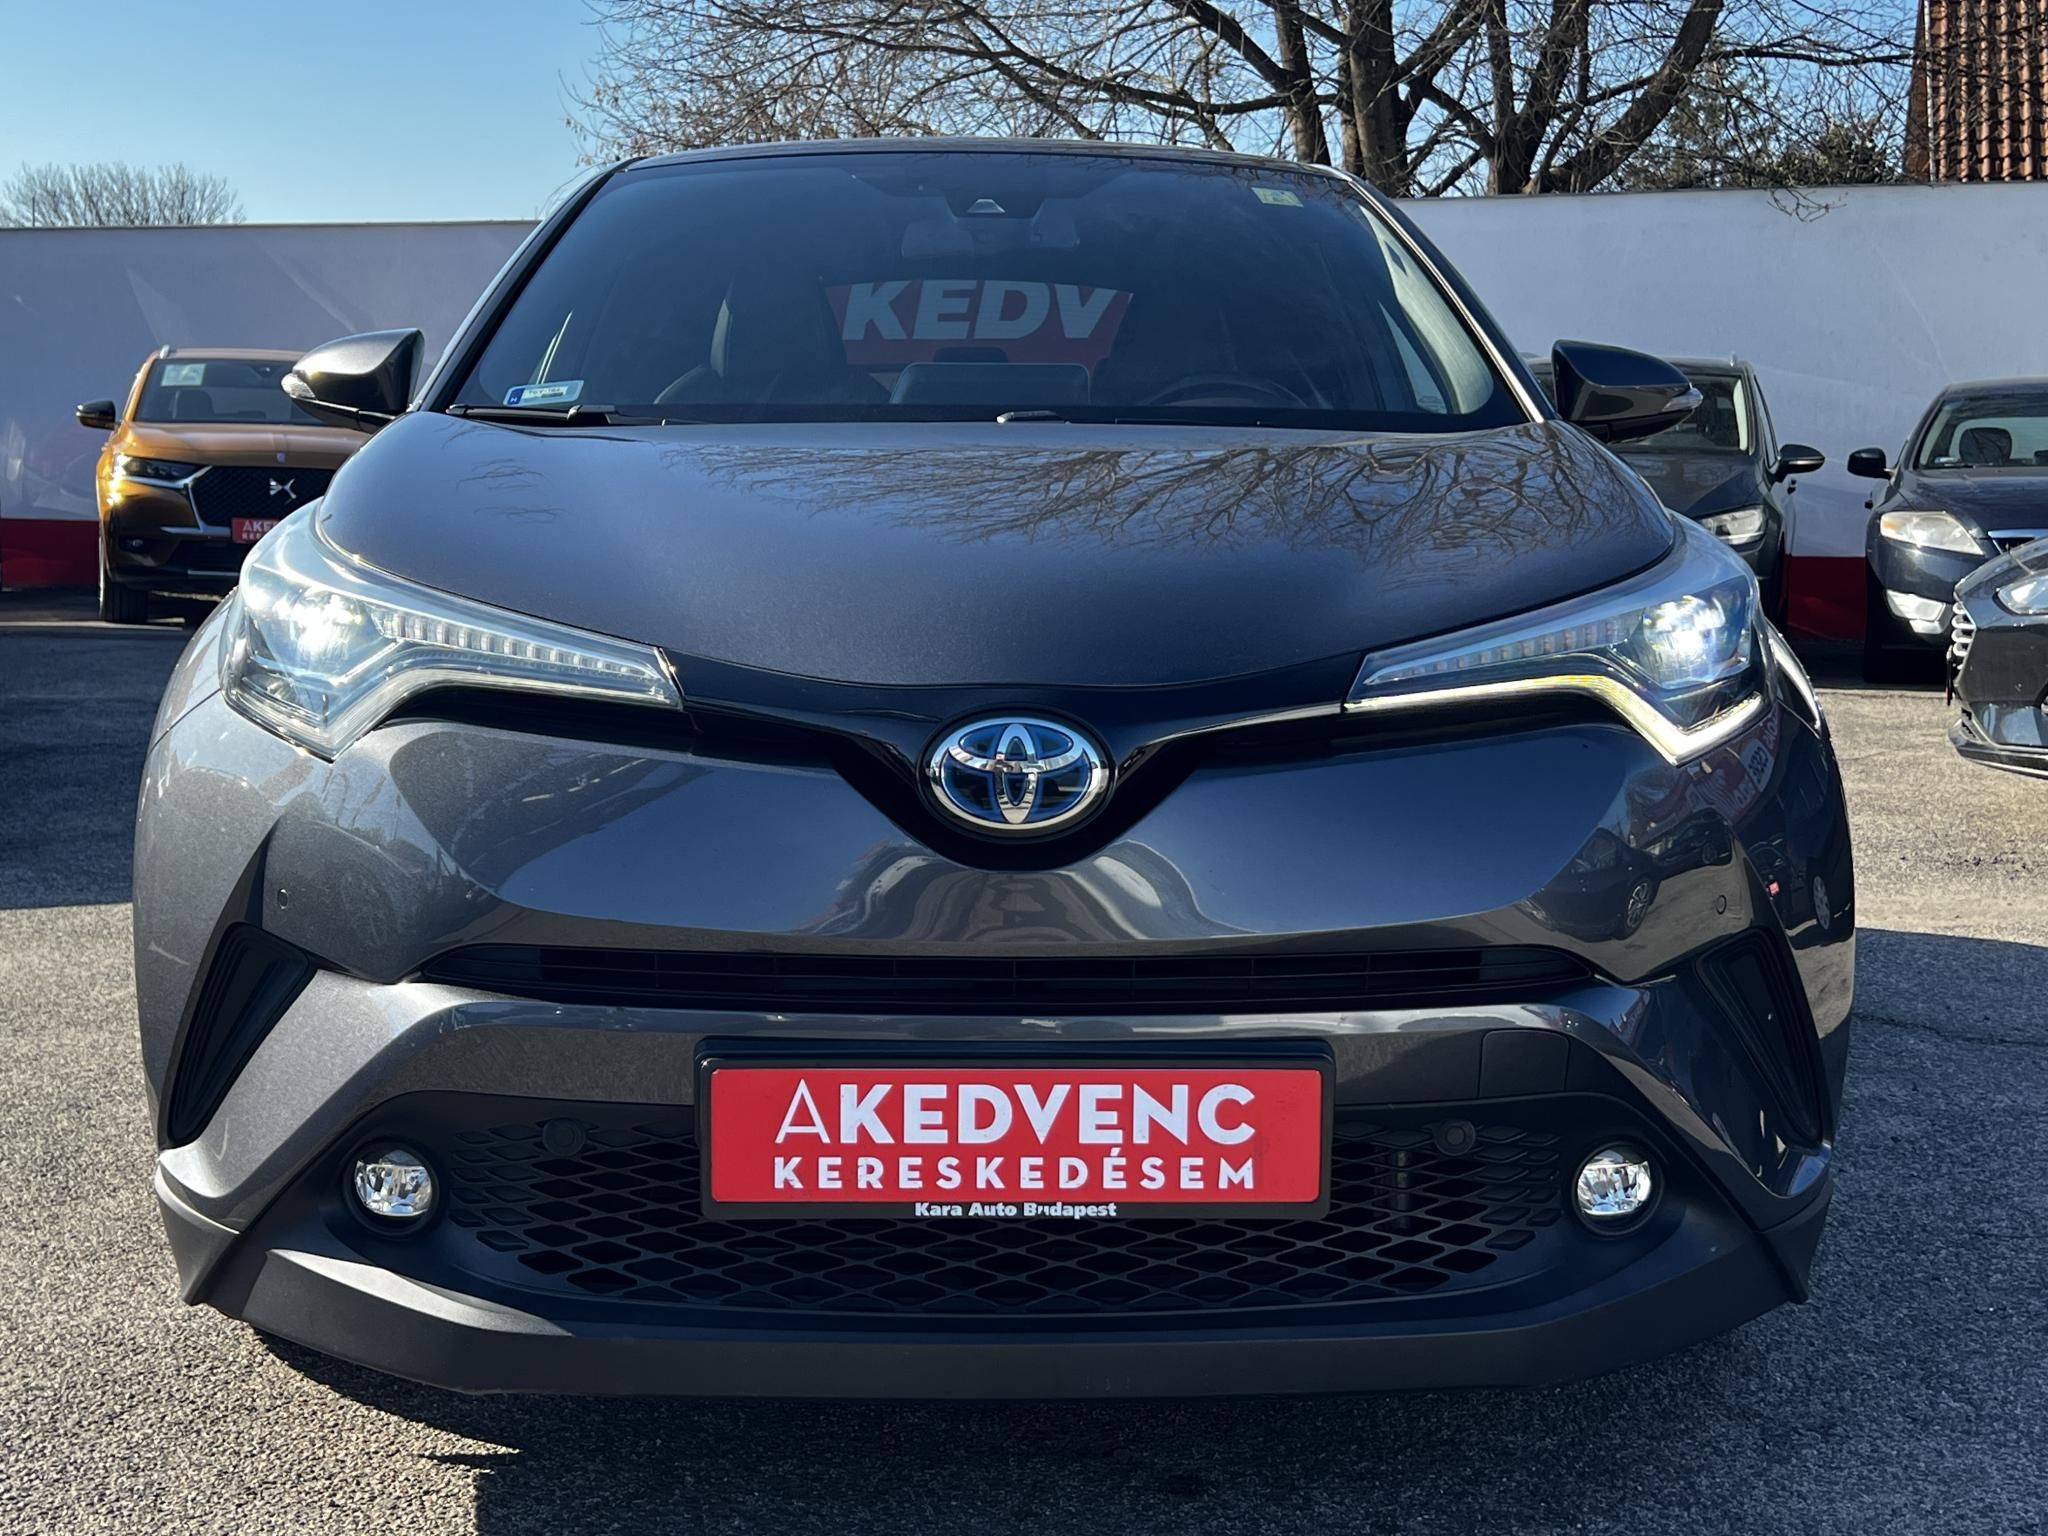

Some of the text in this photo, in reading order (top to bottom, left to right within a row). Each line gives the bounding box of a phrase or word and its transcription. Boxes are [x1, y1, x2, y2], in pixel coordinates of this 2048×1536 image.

[774, 1147, 1254, 1190] KERESKEDÉSEM
[915, 1202, 962, 1217] Kara
[968, 1202, 1017, 1217] Auto
